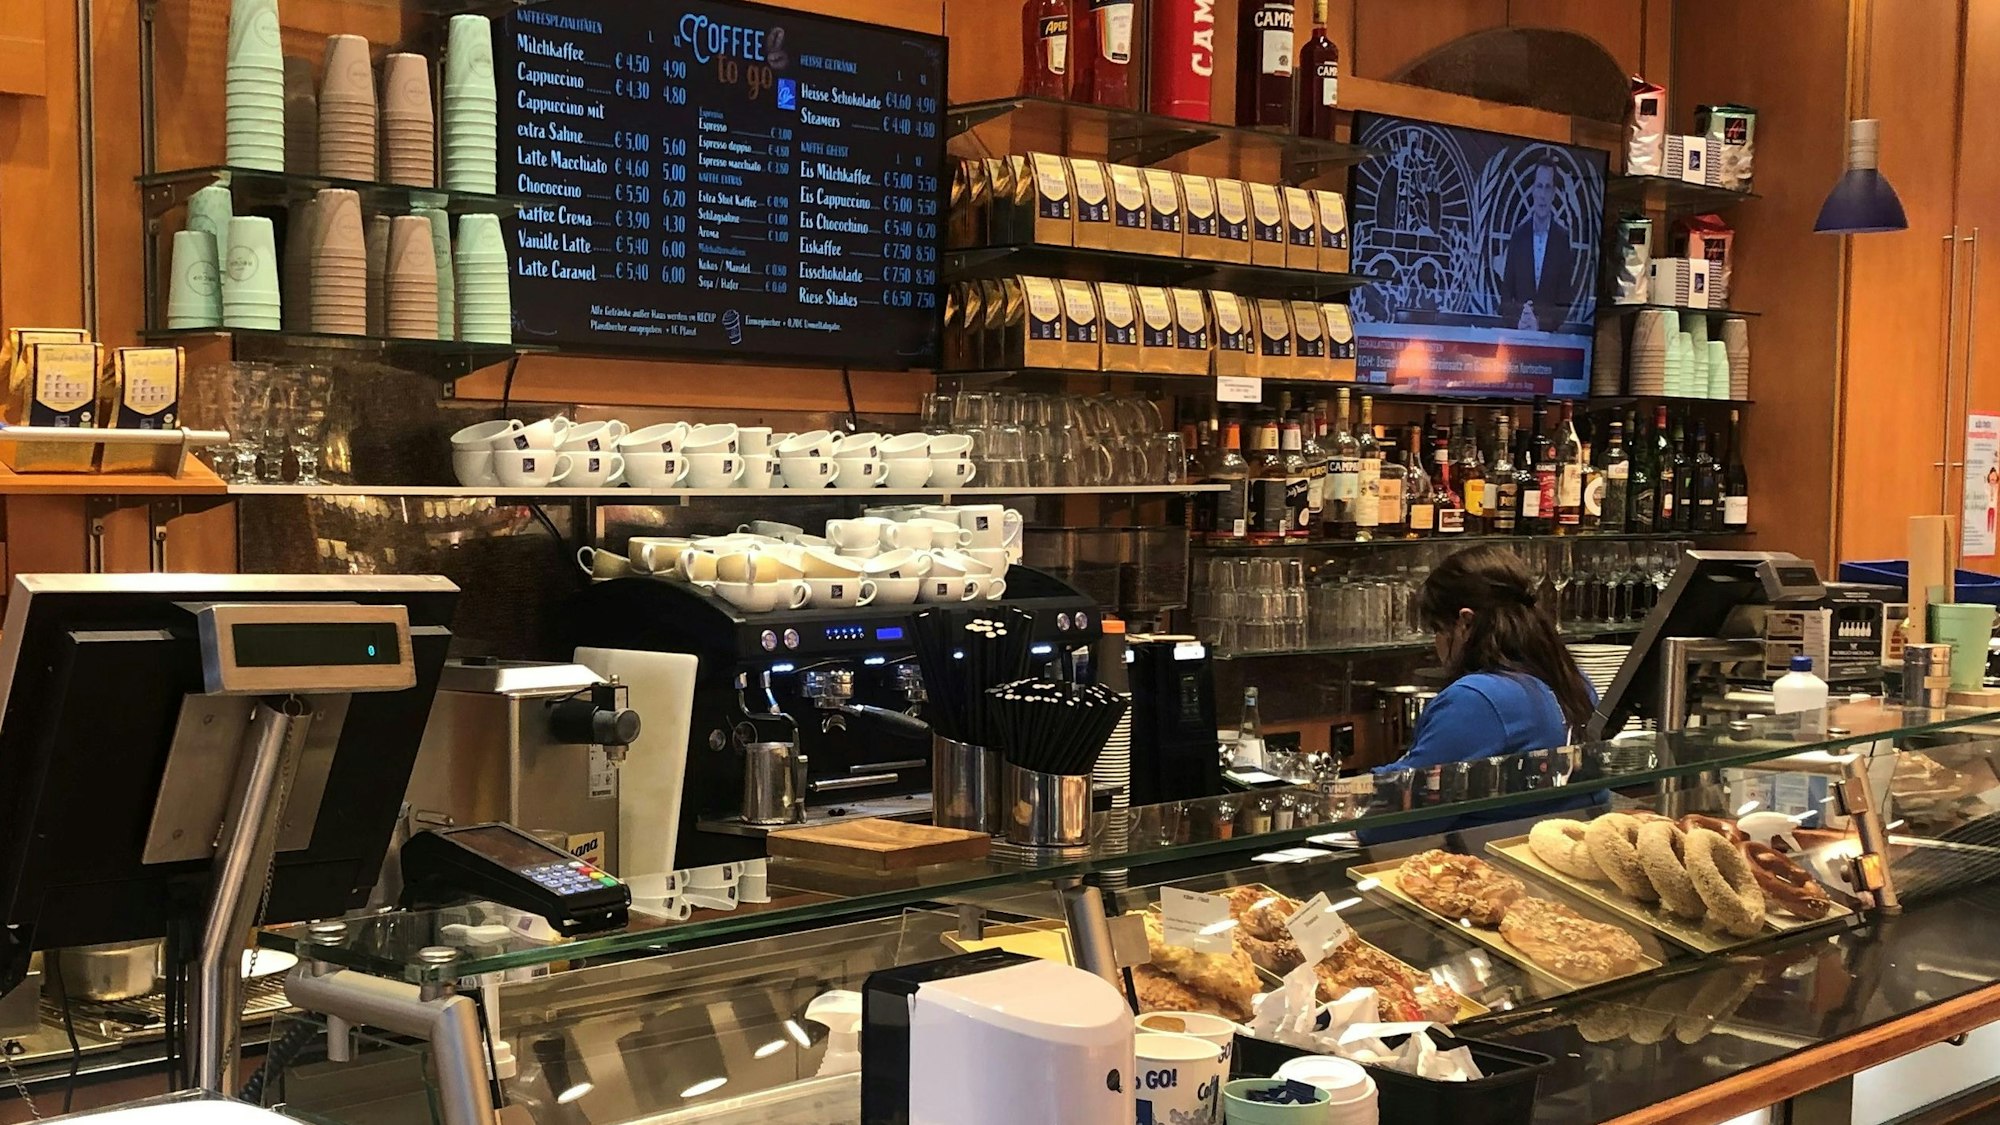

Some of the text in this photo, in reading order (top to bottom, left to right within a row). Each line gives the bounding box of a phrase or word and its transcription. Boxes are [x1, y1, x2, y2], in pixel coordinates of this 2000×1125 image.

[679, 13, 765, 64] COFFEE
[517, 33, 585, 61] Milchkaffee
[615, 52, 623, 70] €
[517, 61, 584, 89] Cappuccino
[615, 78, 623, 96] €
[717, 54, 738, 84] to
[747, 64, 773, 100] go
[517, 89, 605, 120] Cappuccino mit
[801, 82, 829, 102] Heisse
[831, 87, 881, 110] Schokolade
[699, 117, 727, 132] Espresso
[800, 107, 841, 128] Steamers
[883, 116, 890, 132] €
[517, 121, 545, 139] extra
[548, 121, 584, 144] Sahne
[614, 131, 623, 148] €
[699, 135, 727, 150] Espresso
[517, 145, 548, 168] Latte
[550, 149, 608, 174] Macchiato
[614, 157, 623, 175] €
[699, 152, 727, 168] Espresso
[800, 160, 814, 178] Eis
[817, 162, 872, 185] Milchkaffee
[884, 171, 891, 187] €
[517, 173, 582, 199] Chococcino
[615, 183, 623, 201] €
[699, 190, 716, 203] Extra
[735, 194, 757, 208] Kaffee
[800, 185, 814, 204] Eis
[816, 187, 871, 210] Cappuccino
[883, 195, 890, 211] €
[558, 205, 592, 227] Crema
[615, 210, 623, 227] €
[800, 211, 814, 229] Eis
[884, 219, 891, 235] €
[518, 228, 560, 251] Vanille
[562, 233, 592, 254] Latte
[615, 235, 623, 253] €
[698, 225, 720, 239] Aroma
[800, 236, 841, 256] Eiskaffee
[883, 242, 891, 259] €
[518, 257, 549, 277] Latte
[551, 260, 597, 281] Caramel
[616, 262, 624, 279] €
[799, 261, 863, 283] Eisschokolade
[883, 266, 891, 282] €
[799, 287, 824, 305] Riese
[826, 288, 858, 308] Shakes
[883, 290, 890, 305] €
[1145, 1068, 1178, 1090] GO!
